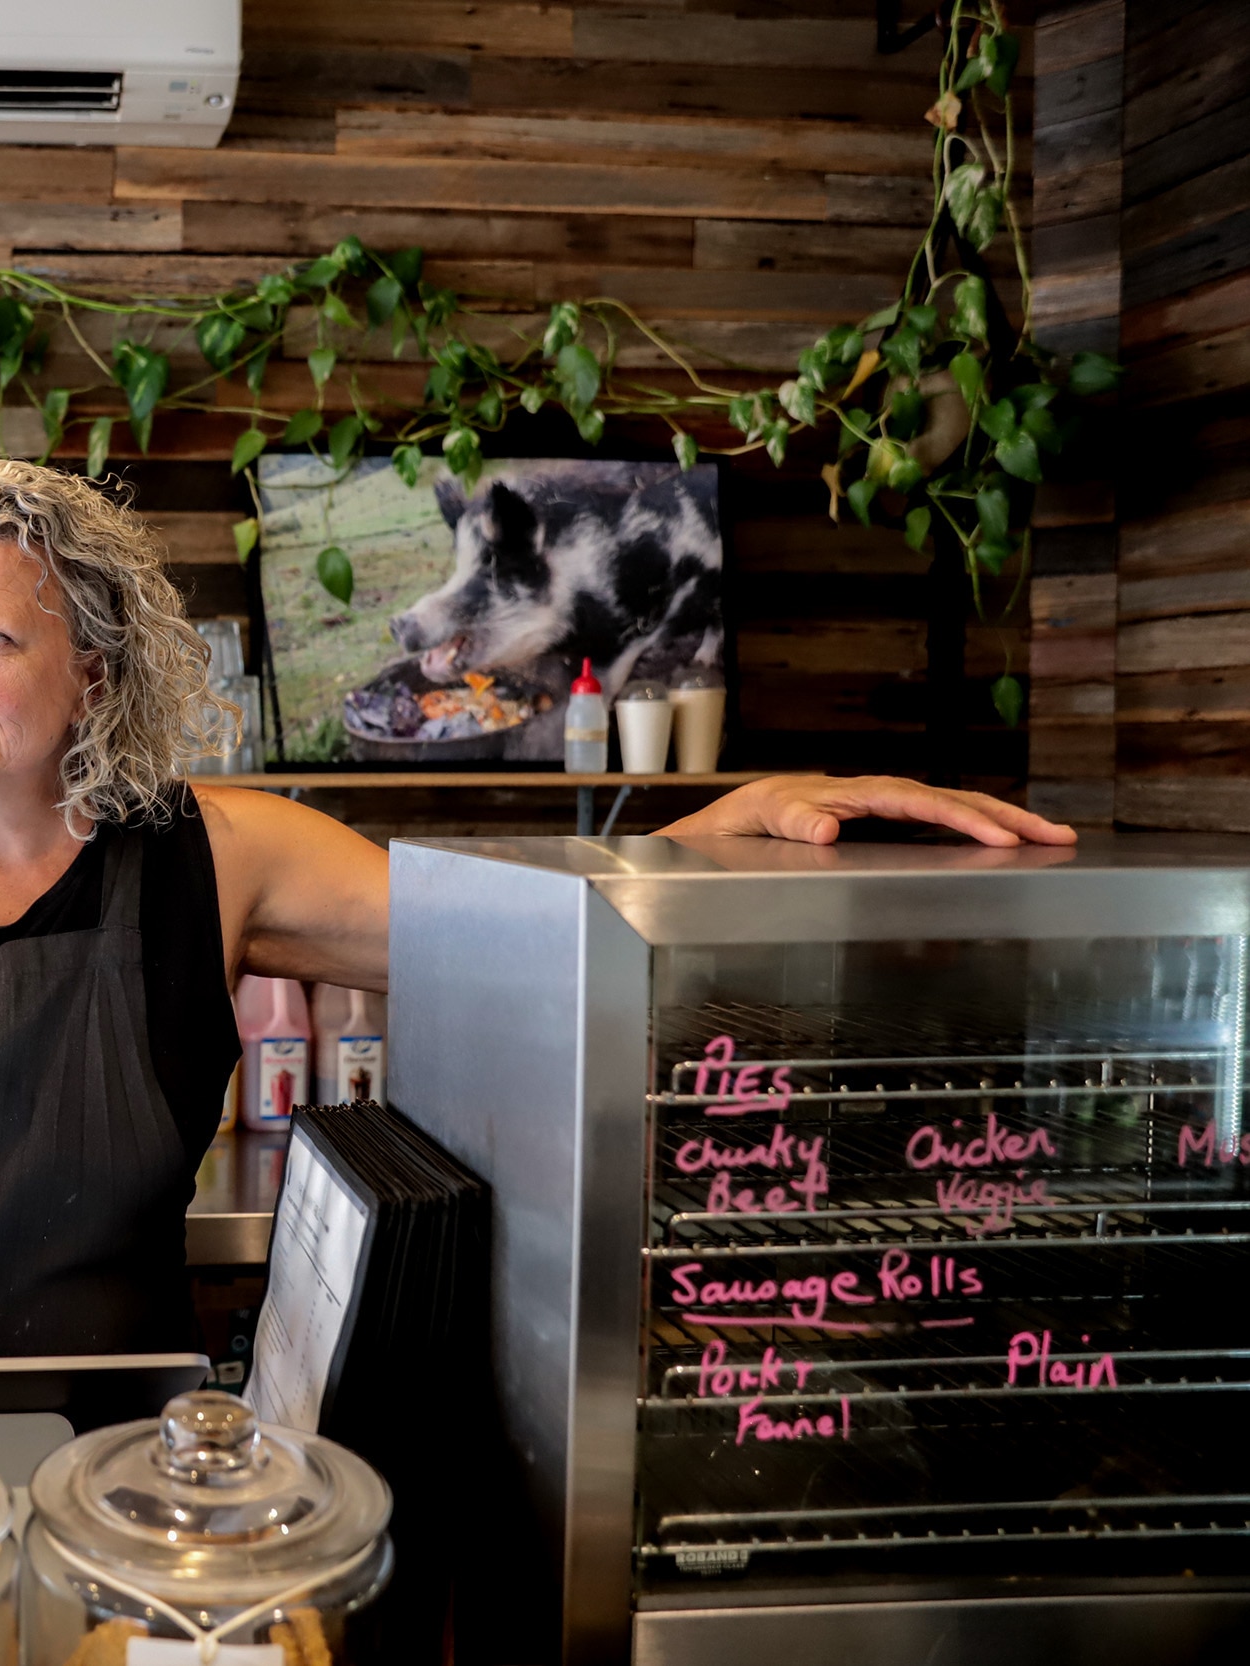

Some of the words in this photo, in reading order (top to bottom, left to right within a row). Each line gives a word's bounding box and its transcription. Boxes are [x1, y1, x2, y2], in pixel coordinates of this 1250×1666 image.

[905, 1112, 1056, 1170] Chicken
[936, 1169, 1056, 1236] Veggie
[670, 1263, 875, 1322] Sausage
[877, 1248, 984, 1299] Rolls
[1007, 1329, 1118, 1390] Plain
